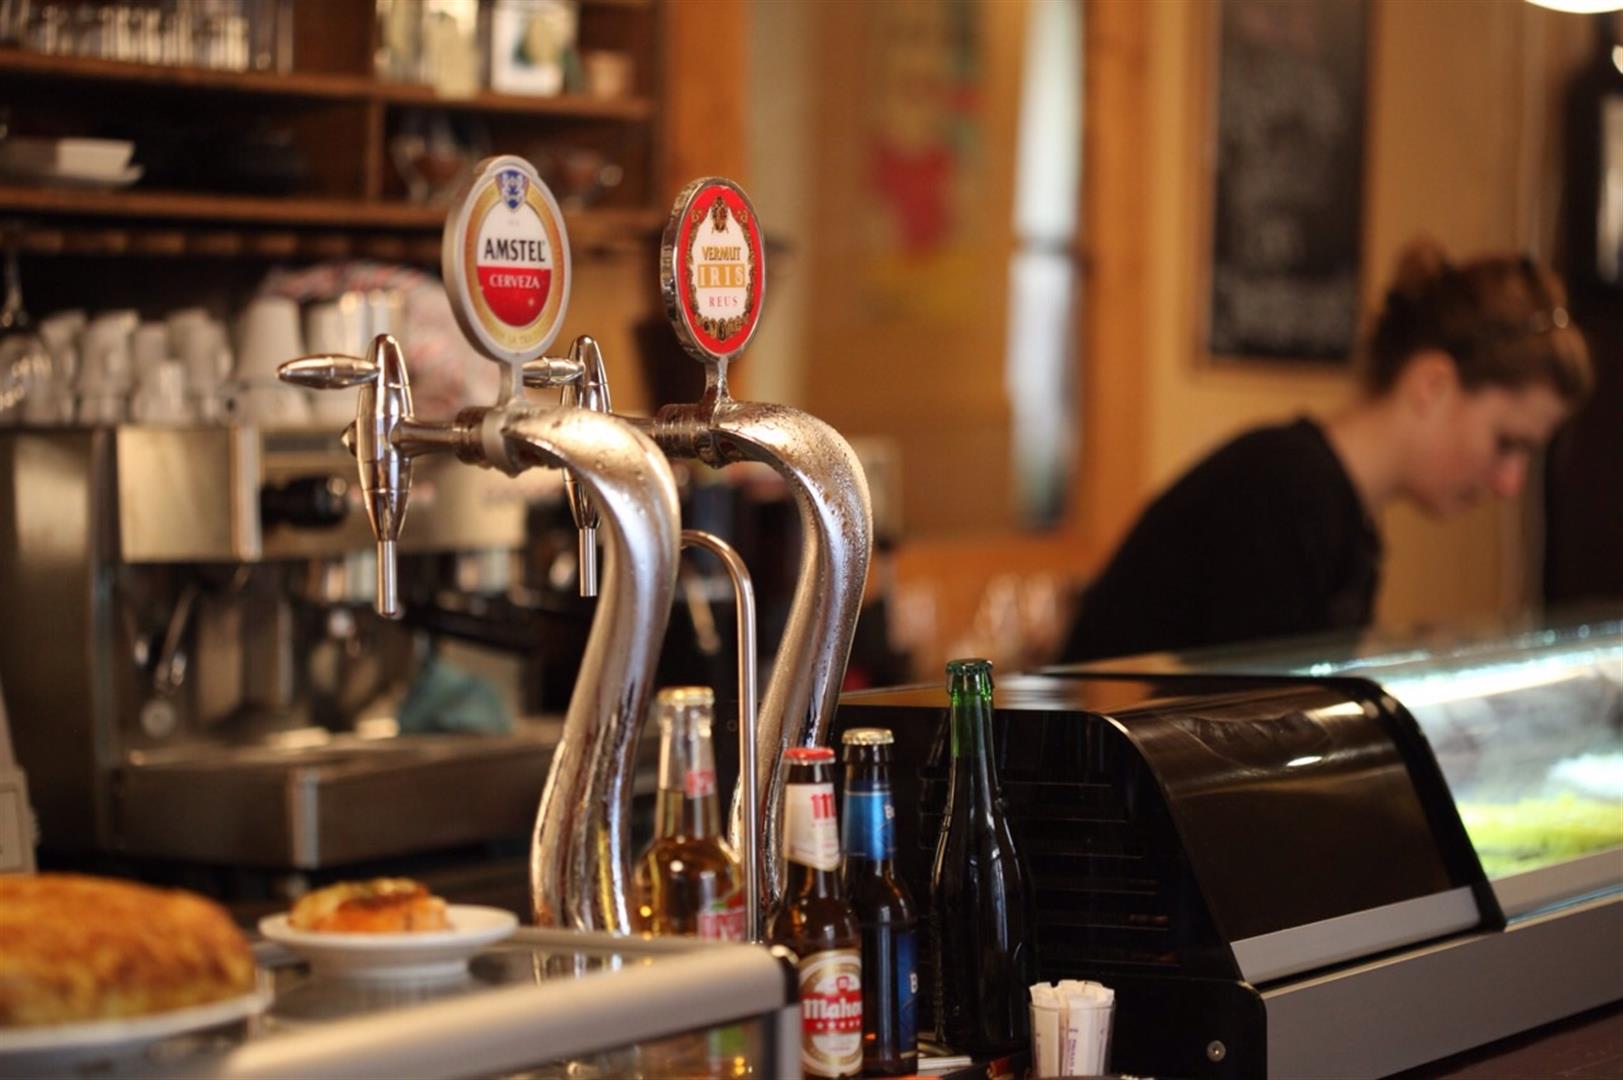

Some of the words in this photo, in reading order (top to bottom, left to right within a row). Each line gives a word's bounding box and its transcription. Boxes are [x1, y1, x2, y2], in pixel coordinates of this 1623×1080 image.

[484, 237, 545, 262] AMSTEL
[701, 246, 741, 261] VERMUT
[489, 273, 541, 289] CERVEZA
[699, 265, 745, 287] IRIS
[708, 295, 738, 308] REUS
